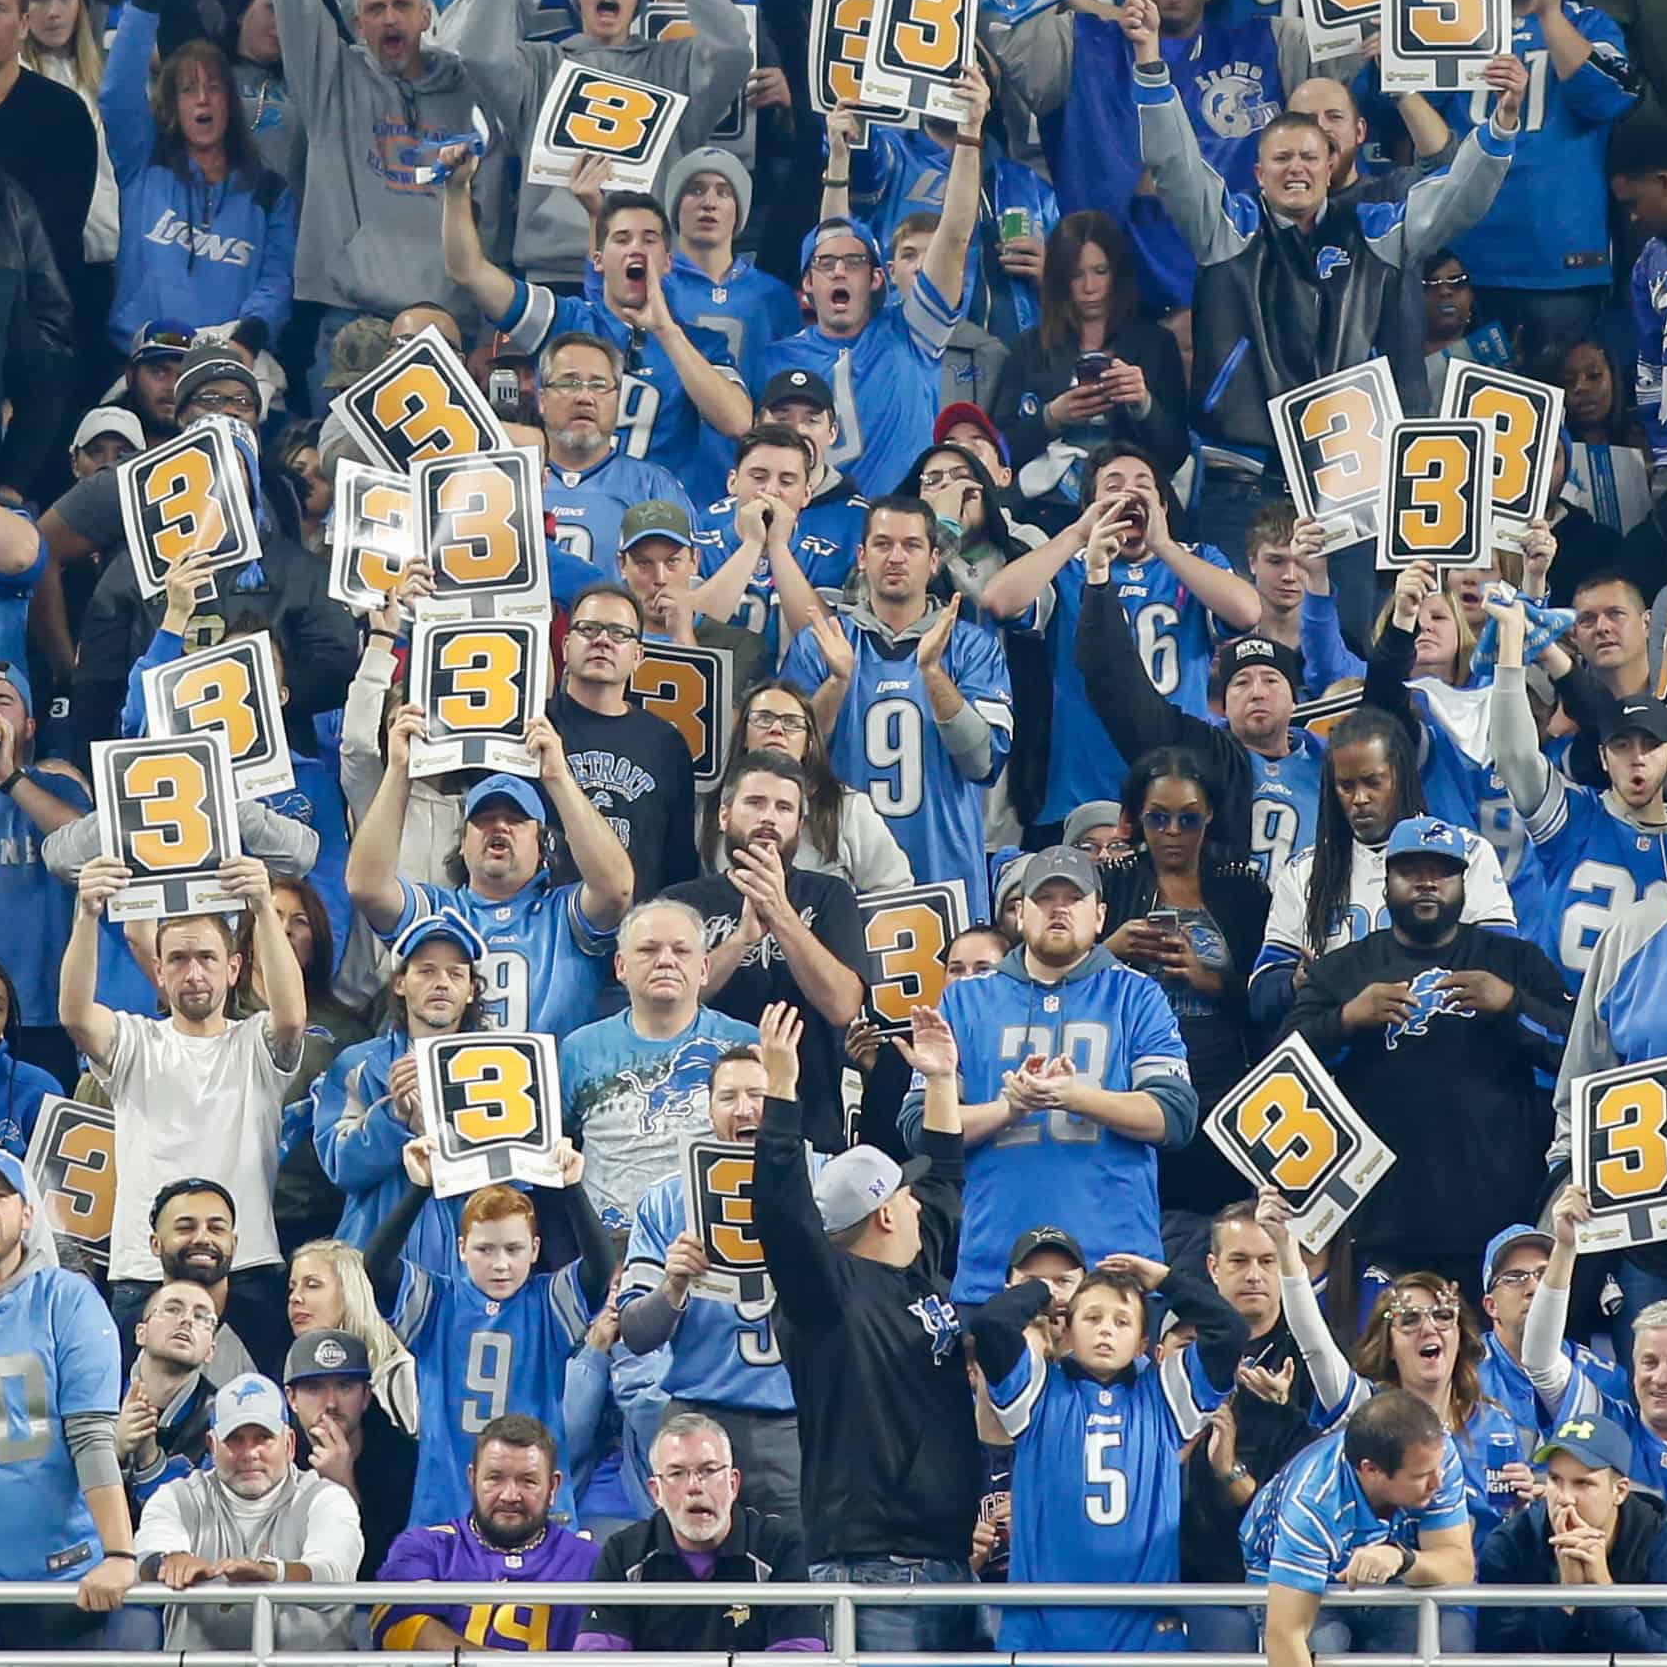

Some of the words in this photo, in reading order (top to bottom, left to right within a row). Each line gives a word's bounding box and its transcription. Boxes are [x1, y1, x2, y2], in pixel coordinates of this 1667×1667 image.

[1195, 64, 1264, 91] LIONS
[144, 209, 255, 267] LIONS
[373, 366, 478, 457] 3
[436, 462, 520, 582] 3
[1400, 438, 1469, 549] 3
[183, 661, 256, 756] 3
[440, 635, 519, 728] 3
[874, 678, 911, 695] LIONS
[567, 752, 663, 810] ETROIT
[864, 698, 924, 819] 9
[127, 756, 211, 869] 3
[1250, 797, 1300, 878] 9
[450, 1048, 534, 1141] 3
[1238, 1075, 1336, 1189] 3
[462, 1331, 514, 1433] 9
[1084, 1430, 1129, 1527] 5
